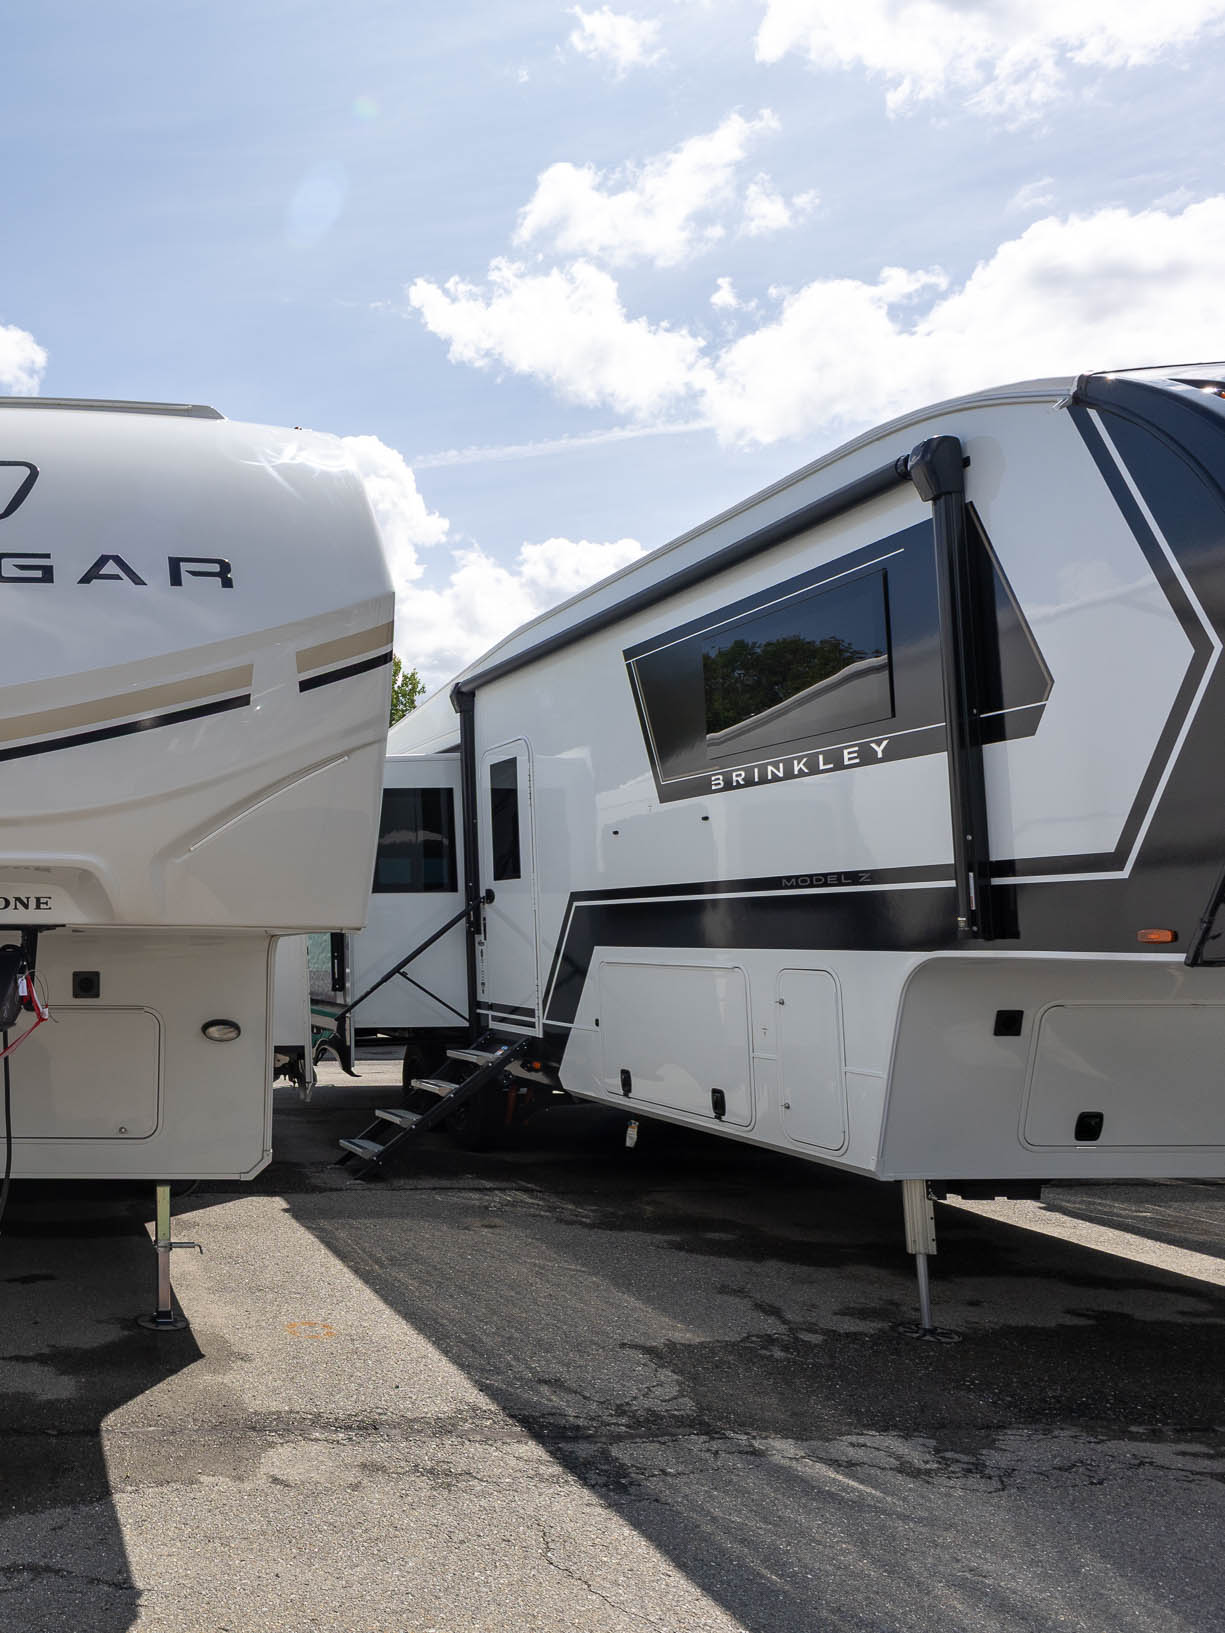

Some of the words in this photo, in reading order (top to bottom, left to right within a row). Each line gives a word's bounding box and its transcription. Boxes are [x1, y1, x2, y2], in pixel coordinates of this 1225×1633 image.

[711, 739, 889, 790] BRINKLEY
[782, 874, 852, 887] MODEL
[858, 872, 872, 882] Z
